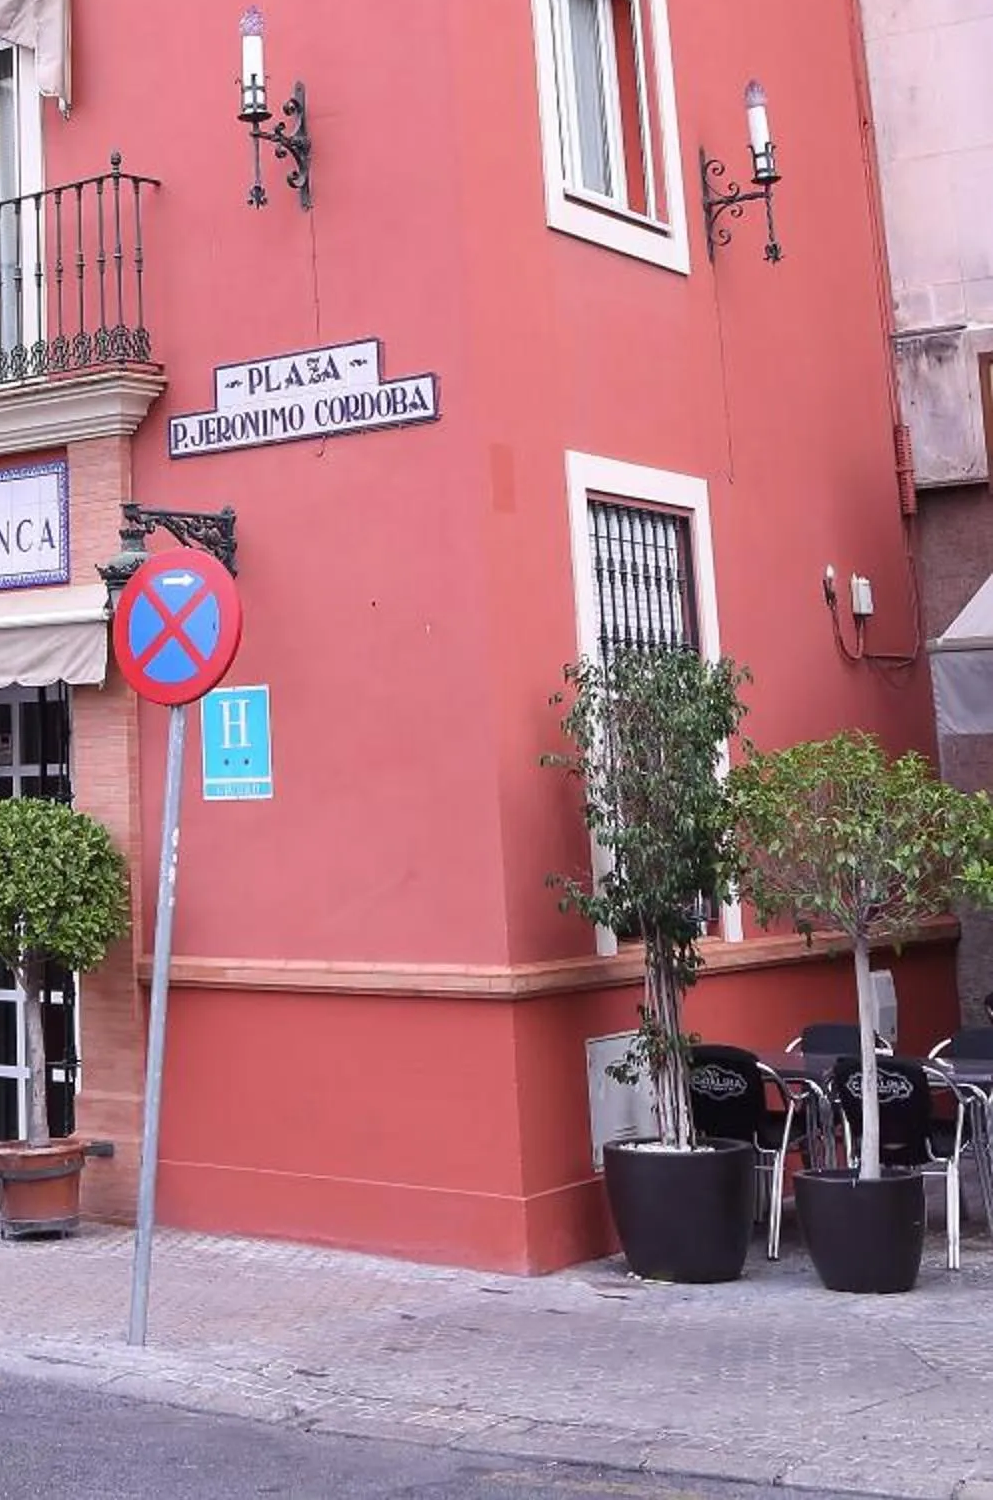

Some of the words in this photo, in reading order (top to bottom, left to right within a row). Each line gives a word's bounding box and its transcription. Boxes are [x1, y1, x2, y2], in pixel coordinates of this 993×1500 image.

[247, 353, 341, 395] PLAZA
[314, 385, 430, 427] CORDOBA
[218, 699, 252, 749] H
